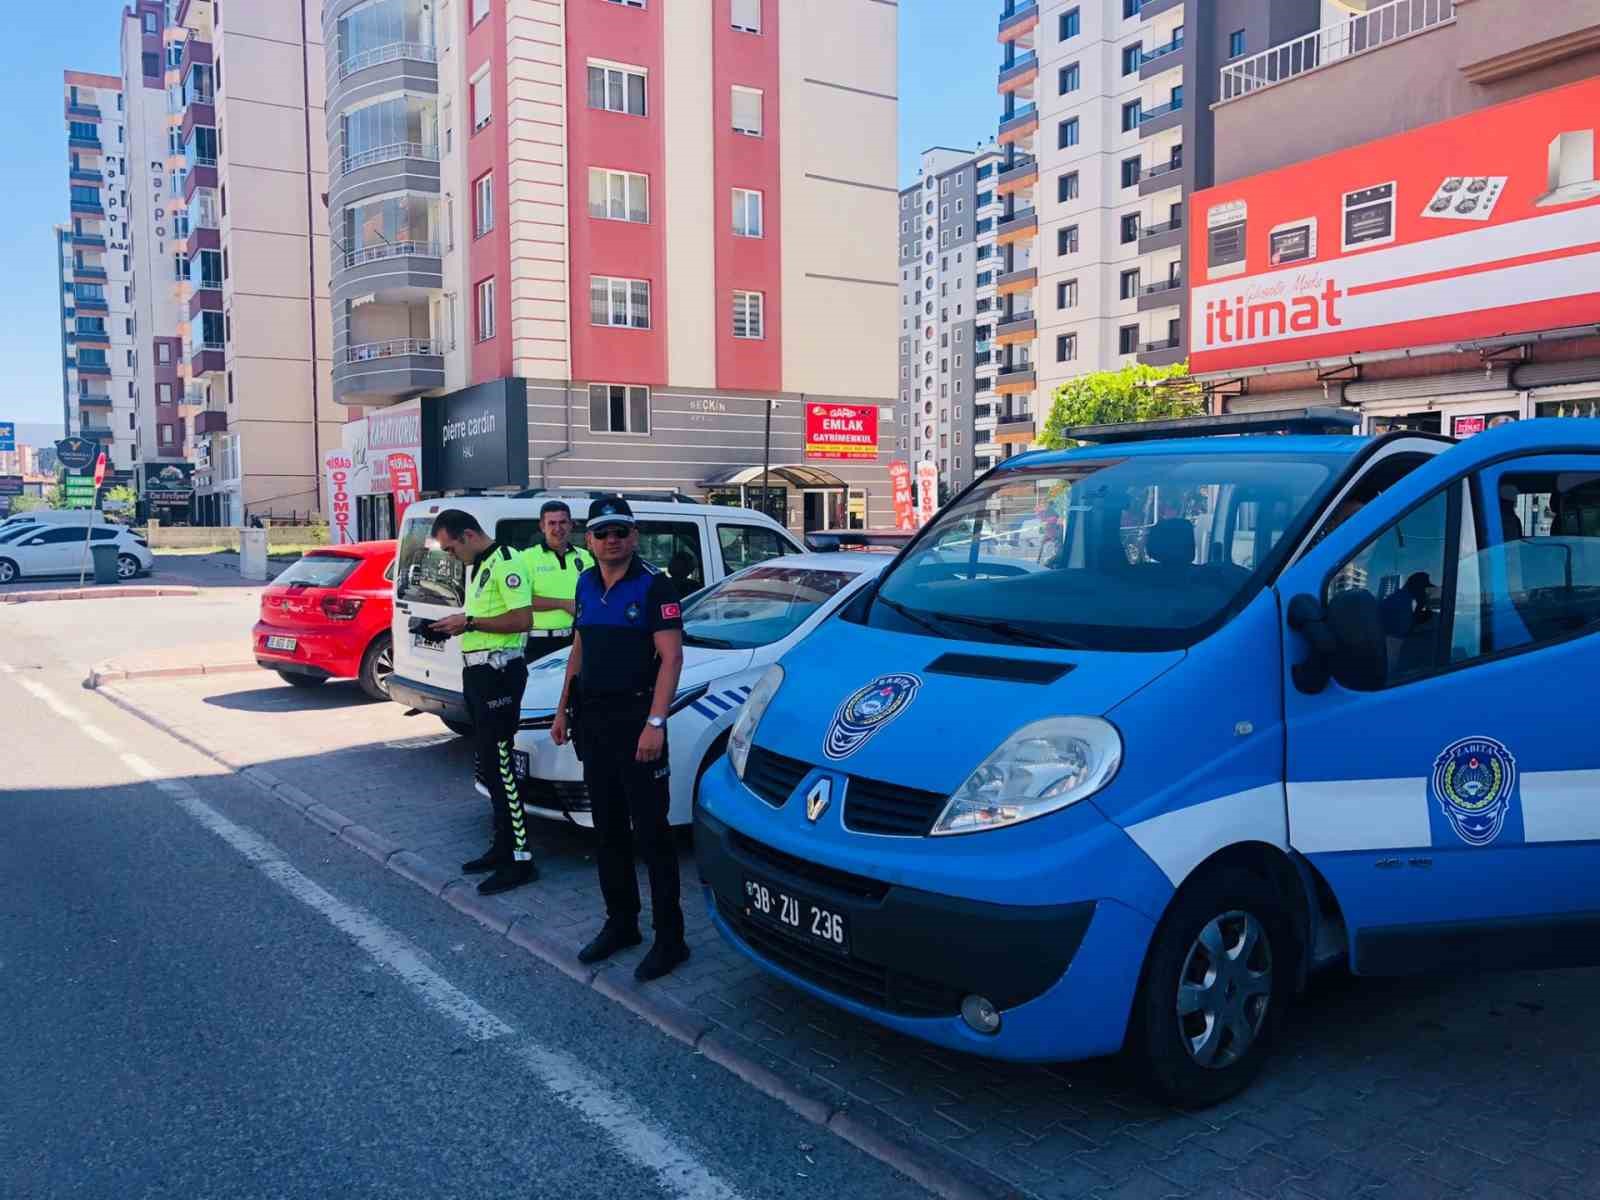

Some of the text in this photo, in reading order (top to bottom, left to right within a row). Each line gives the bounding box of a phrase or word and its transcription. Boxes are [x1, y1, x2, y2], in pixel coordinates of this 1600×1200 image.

[1205, 279, 1342, 345] itimat
[442, 410, 496, 448] pierre cardin
[823, 419, 863, 431] EMLAK
[752, 882, 843, 943] 38 ZU 236
